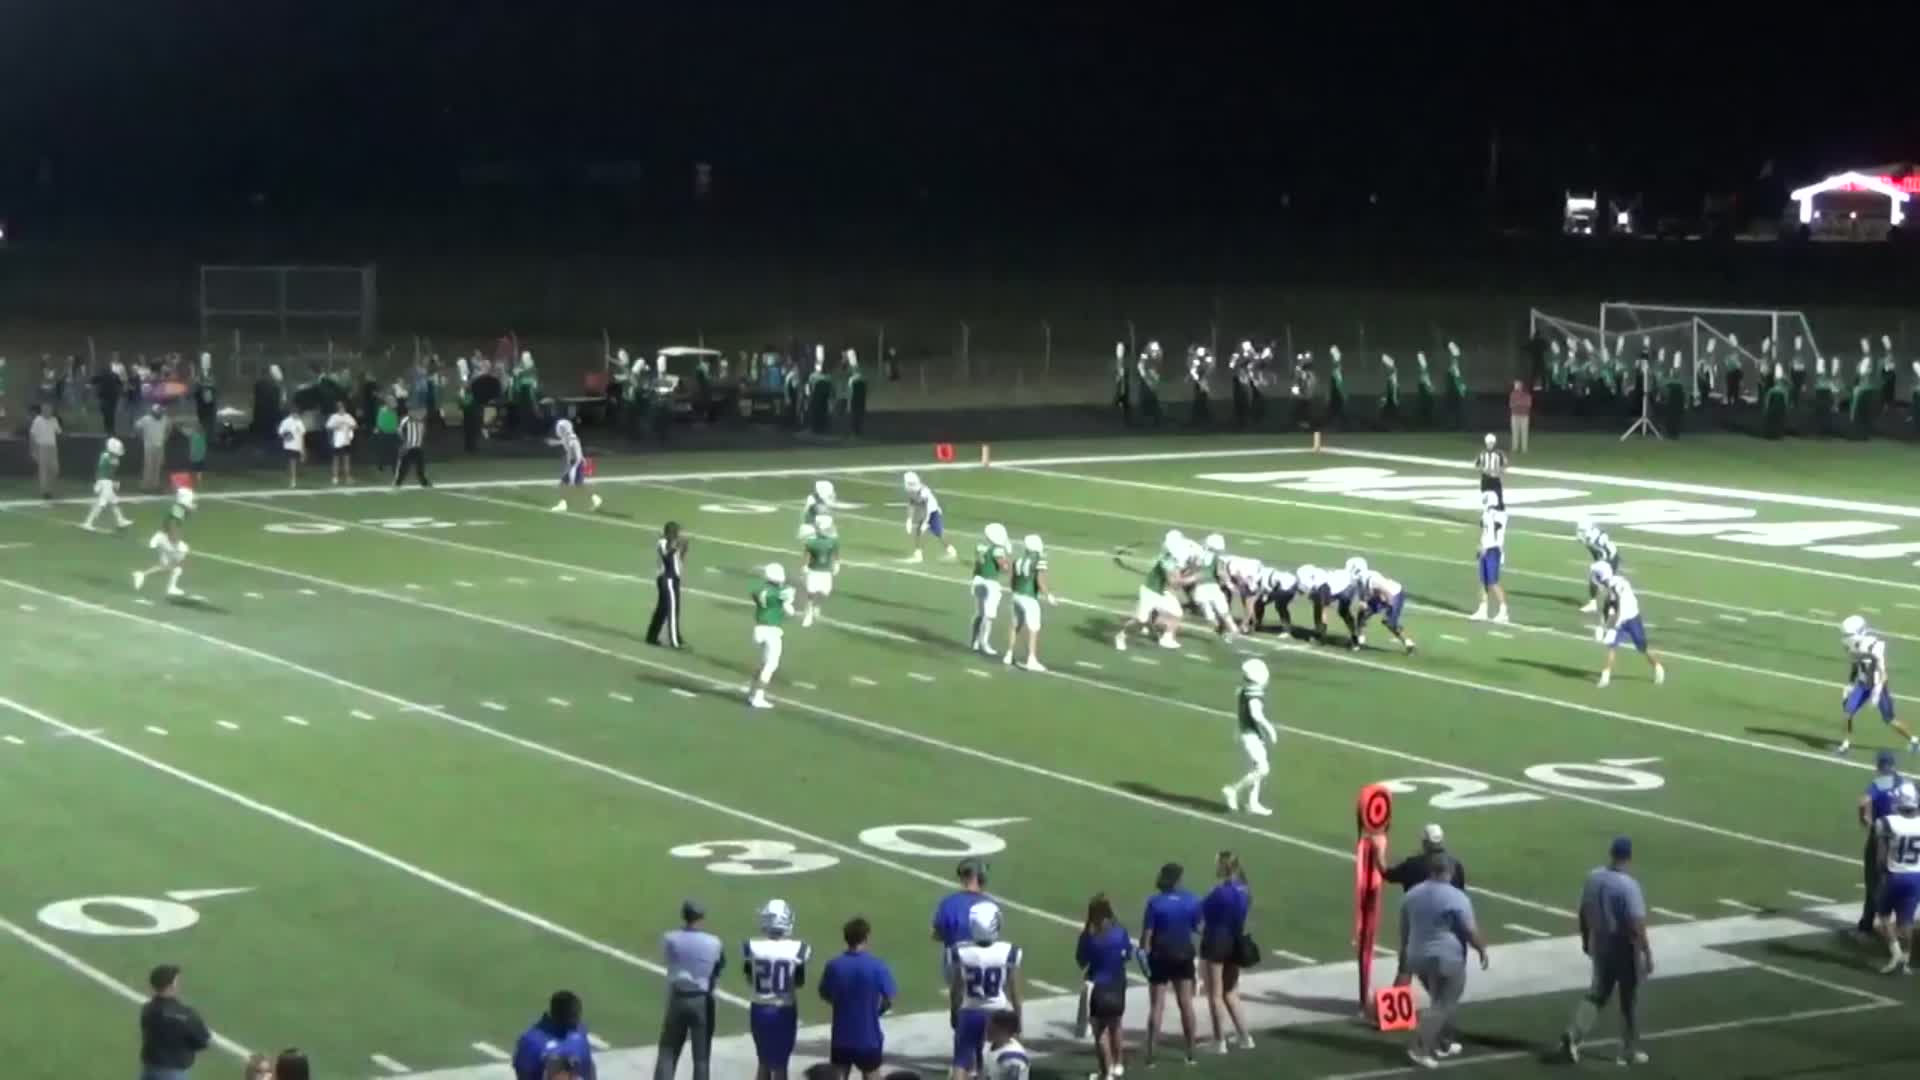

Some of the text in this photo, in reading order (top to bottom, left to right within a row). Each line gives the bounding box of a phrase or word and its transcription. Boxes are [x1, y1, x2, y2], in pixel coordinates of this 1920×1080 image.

[1376, 763, 1665, 809] 20
[669, 825, 1007, 875] 30
[755, 960, 791, 993] 20
[966, 966, 1002, 998] 28
[1381, 991, 1412, 1023] 30
